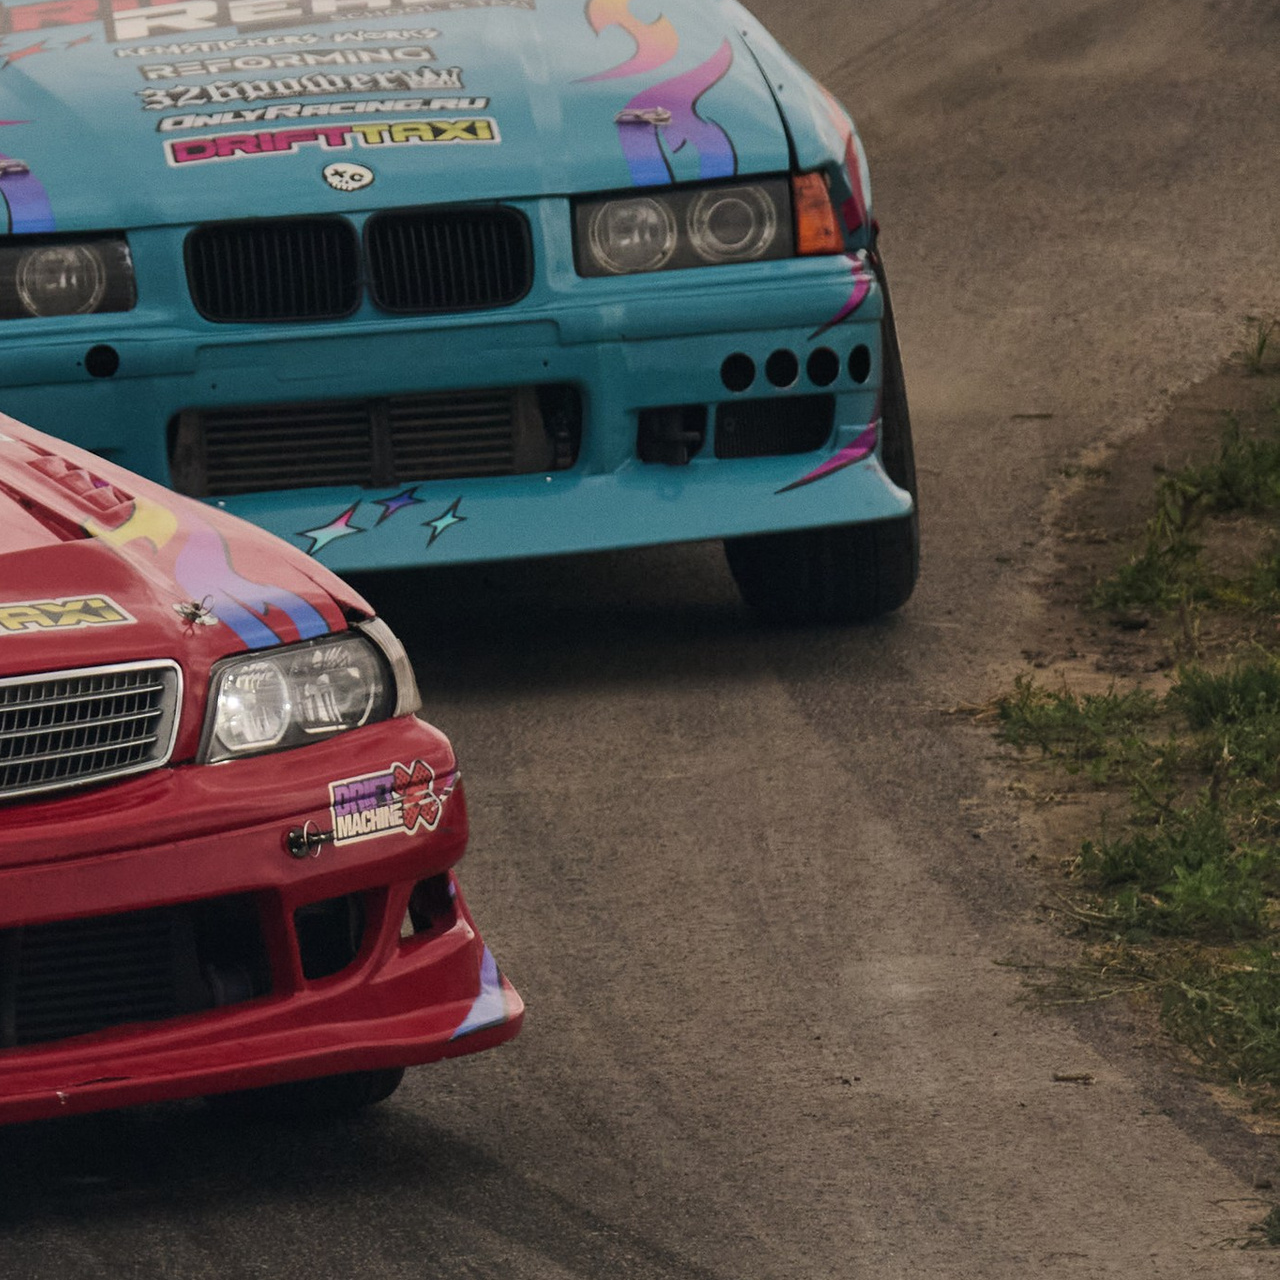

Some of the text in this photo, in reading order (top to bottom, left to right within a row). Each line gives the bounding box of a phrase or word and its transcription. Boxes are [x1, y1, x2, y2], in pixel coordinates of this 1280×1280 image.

[332, 27, 441, 43] WORKS
[140, 46, 435, 80] REFORMING
[334, 774, 395, 816] DRIFT
[336, 802, 404, 839] MACHINE
